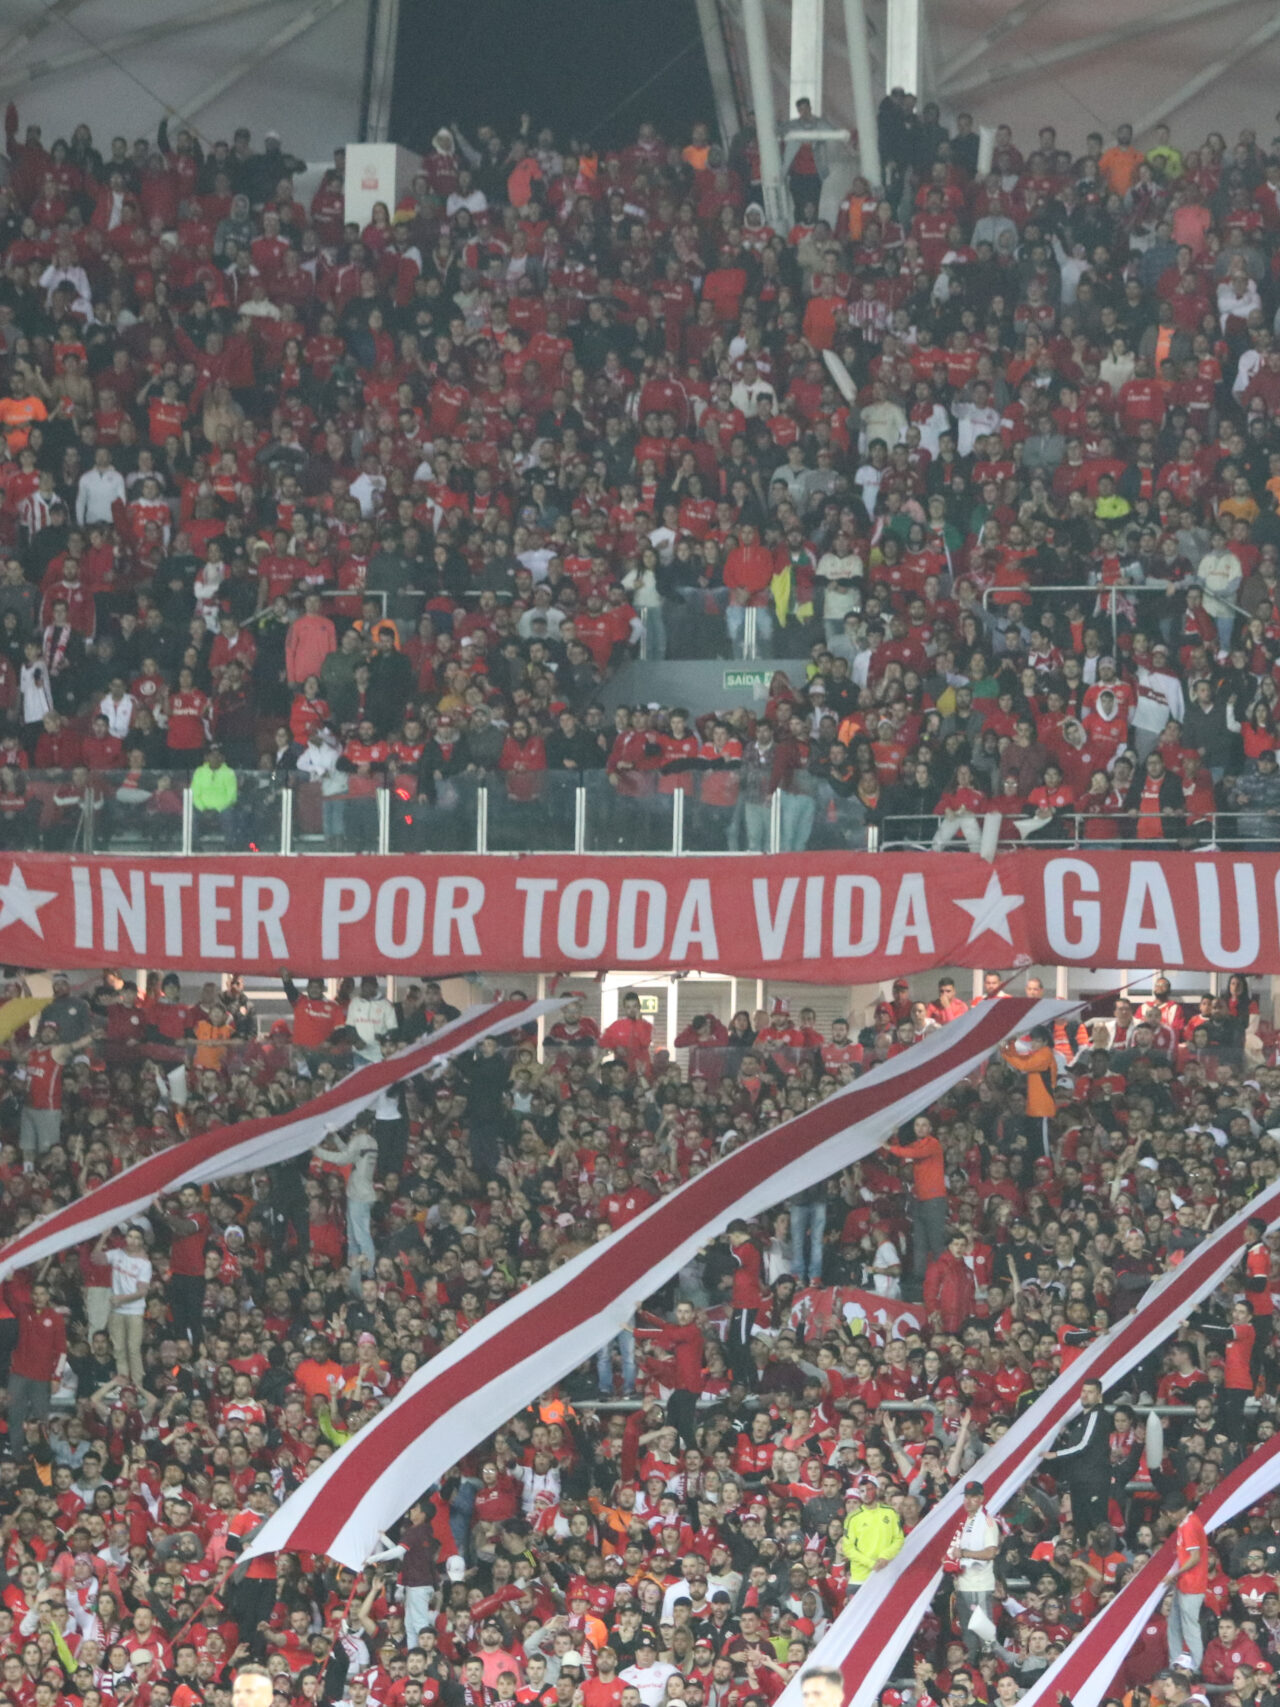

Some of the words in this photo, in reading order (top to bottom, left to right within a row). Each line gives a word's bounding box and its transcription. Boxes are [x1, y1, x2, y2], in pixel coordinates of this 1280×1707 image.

[71, 866, 290, 960] INTER
[321, 876, 485, 960] POR
[515, 877, 719, 961] TODA
[752, 872, 935, 961] VIDA
